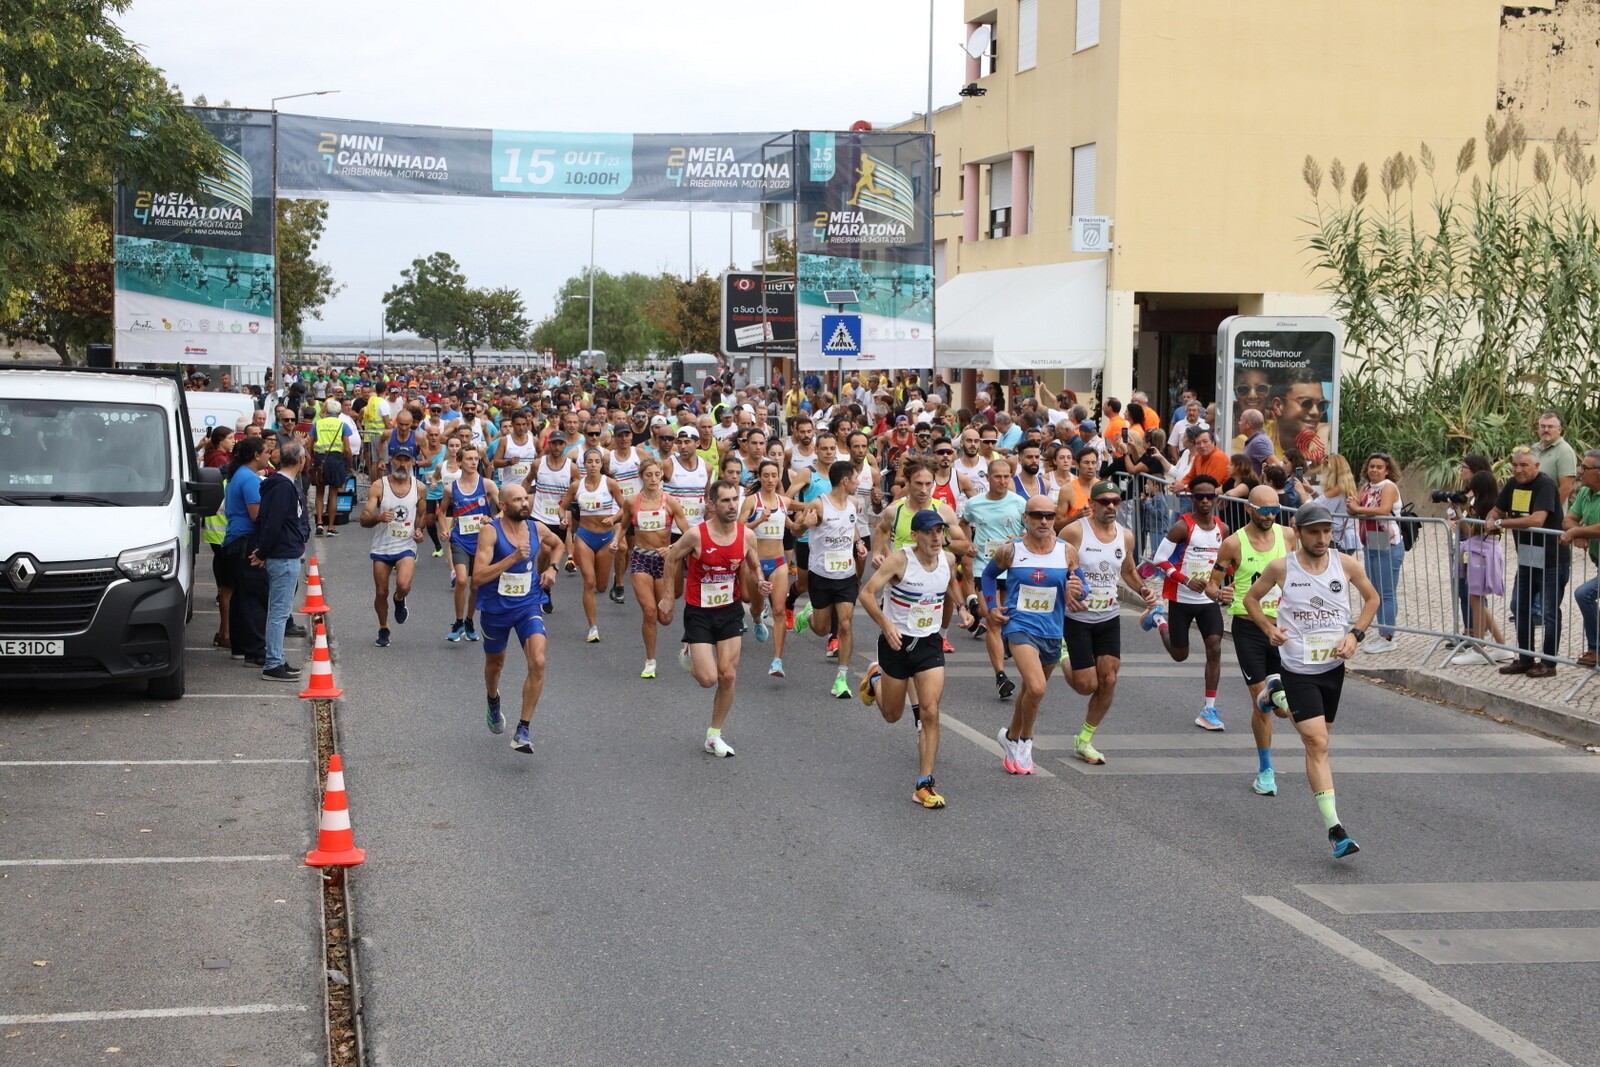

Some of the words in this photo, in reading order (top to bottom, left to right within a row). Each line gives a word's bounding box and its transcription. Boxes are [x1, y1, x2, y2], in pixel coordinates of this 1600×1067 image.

[340, 134, 384, 151] MINI
[688, 147, 735, 162] MEIA
[813, 147, 833, 162] 15
[337, 151, 448, 171] CAMINHADA
[499, 148, 557, 185] 15
[341, 167, 393, 177] RIBEIRINHA
[396, 170, 425, 179] MOITA
[426, 171, 449, 180] 2023
[685, 163, 790, 178] MARATONA
[564, 171, 620, 185] 10:00H
[689, 180, 738, 188] RIBEIRINHA
[741, 180, 768, 188] MOITA
[769, 180, 790, 189] 2023
[153, 191, 198, 205] MEIA
[151, 205, 243, 220] MARATONA
[829, 211, 865, 224] MEIA
[154, 219, 197, 227] RIBEIRINHA
[200, 220, 224, 229] MOITA
[225, 221, 243, 230] 2023
[827, 224, 906, 236] MARATONA
[830, 236, 867, 244] RIBEIRINHA
[869, 236, 890, 244] MOITA
[890, 236, 906, 244] 2023
[740, 305, 755, 314] Sua
[756, 304, 779, 314] Óica
[1242, 339, 1270, 347] Lentes
[1242, 349, 1302, 358] PhotoGlamour
[1242, 360, 1259, 368] with
[642, 521, 661, 530] 221
[764, 526, 780, 535] 111
[391, 529, 409, 538] 122
[829, 561, 849, 571] 179
[504, 584, 526, 594] 231
[707, 593, 729, 605] 102
[1023, 598, 1050, 610] 144
[1292, 609, 1340, 621] PREVENT
[1310, 647, 1338, 662] 174
